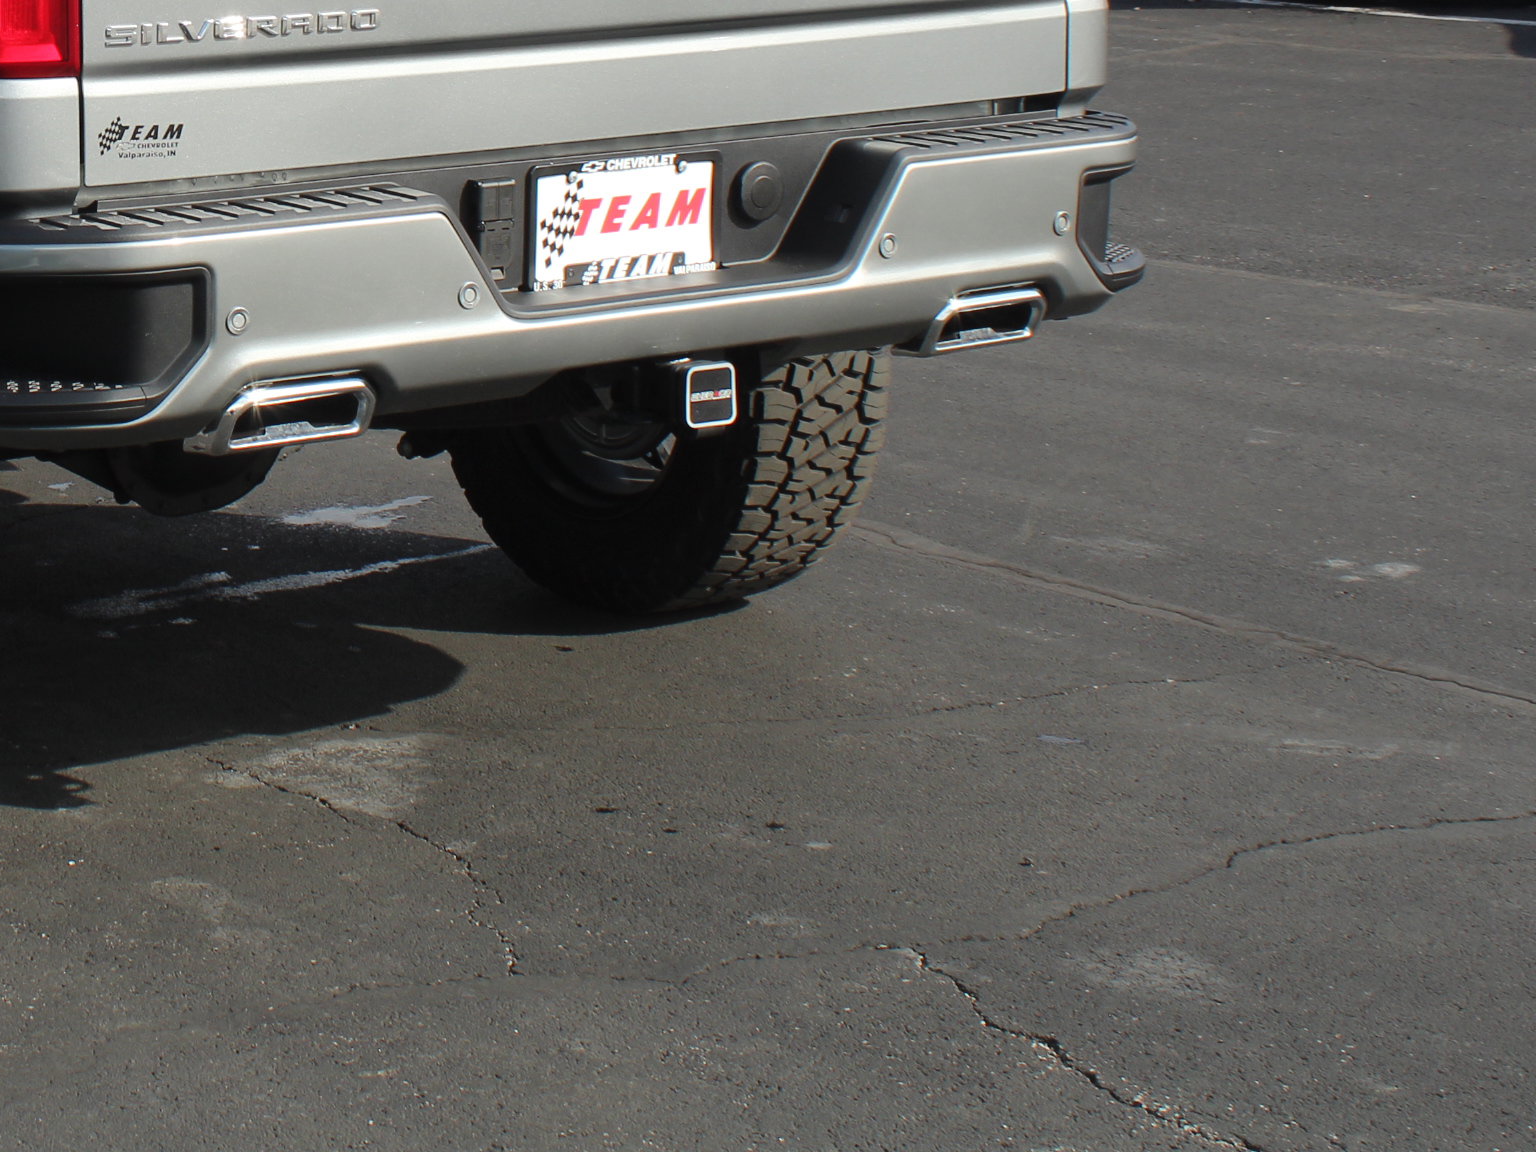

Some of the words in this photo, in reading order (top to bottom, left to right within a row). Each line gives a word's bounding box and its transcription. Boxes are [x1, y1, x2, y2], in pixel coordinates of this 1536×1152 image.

[104, 9, 381, 47] SILVERADO
[117, 124, 184, 140] TEAM
[606, 154, 677, 171] CHEVROLET
[574, 188, 707, 236] TEAM
[598, 252, 674, 283] TEAM
